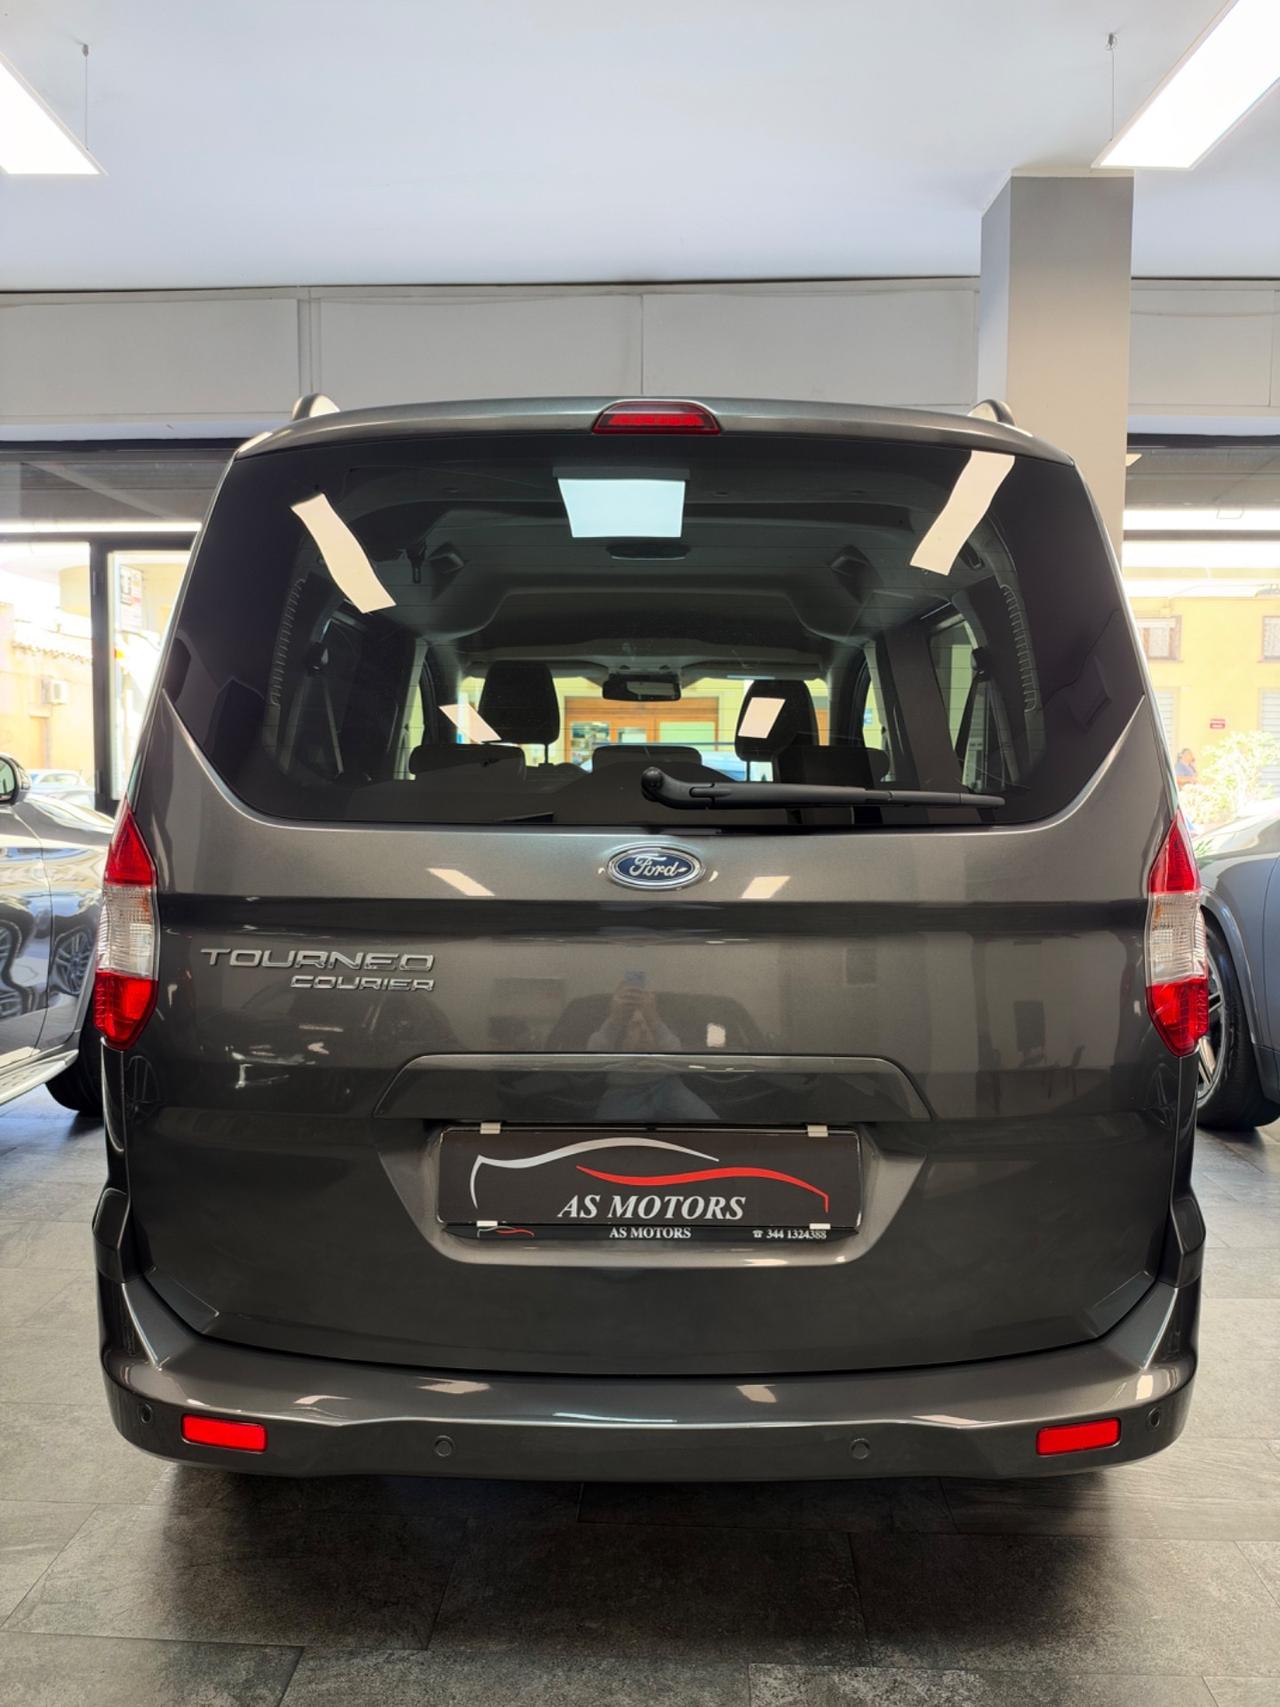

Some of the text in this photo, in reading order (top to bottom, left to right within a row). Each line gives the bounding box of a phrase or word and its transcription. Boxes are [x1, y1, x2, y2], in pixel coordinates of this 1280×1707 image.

[629, 853, 688, 876] Ford
[200, 948, 435, 971] TOURNEO
[291, 975, 435, 991] COURIER
[557, 1195, 746, 1220] AS MOTORS
[609, 1227, 691, 1239] AS MOTORS
[766, 1229, 784, 1239] 344
